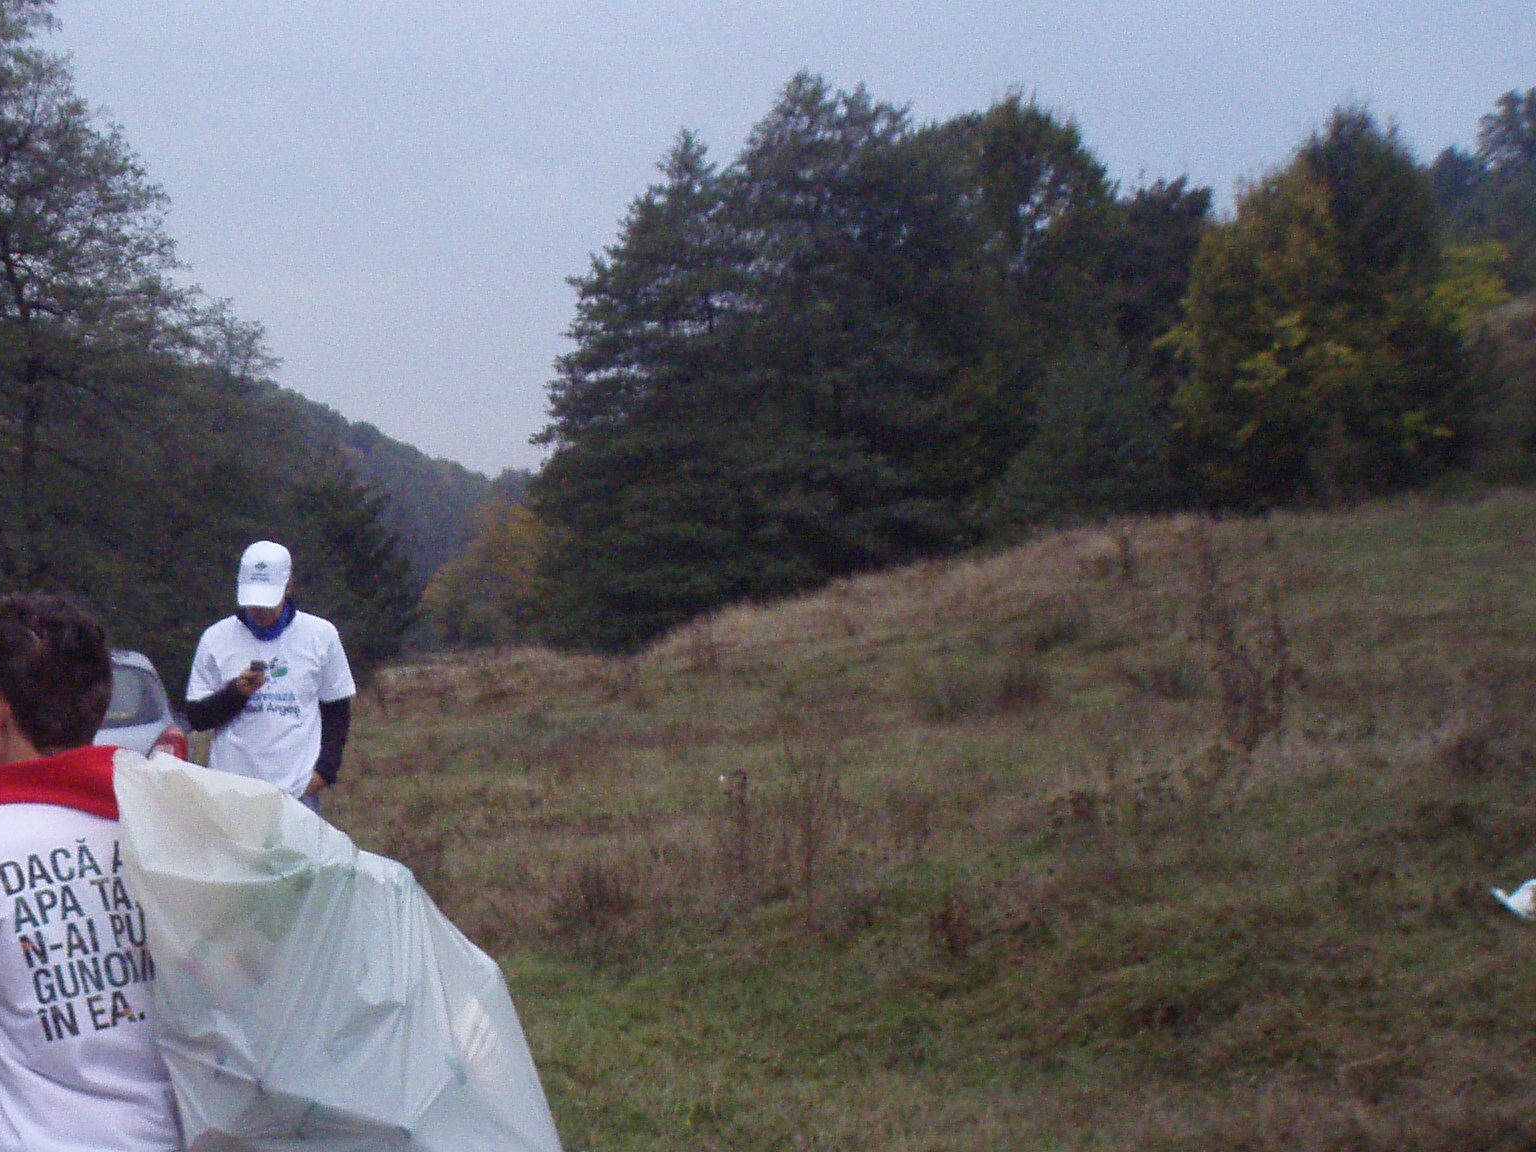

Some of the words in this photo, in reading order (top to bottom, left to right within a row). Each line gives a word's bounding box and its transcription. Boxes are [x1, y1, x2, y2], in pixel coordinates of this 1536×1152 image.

[14, 884, 85, 933] APA
[18, 918, 100, 968] N-AI
[110, 902, 146, 948] PU
[37, 1002, 80, 1041] ÎN
[86, 990, 146, 1031] EA.
